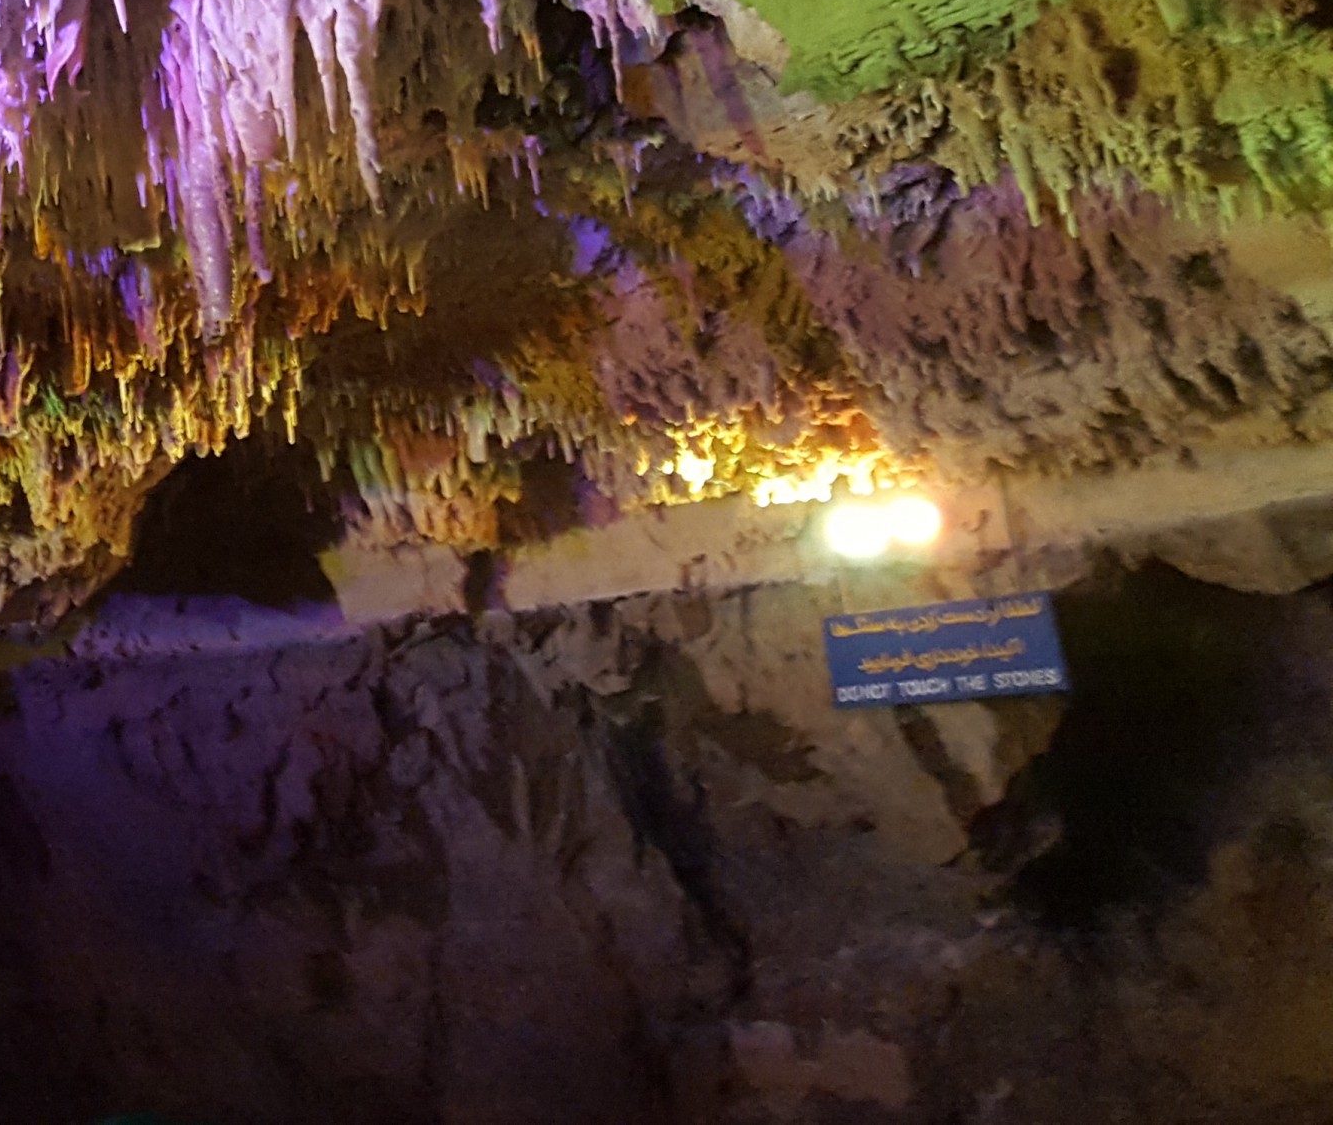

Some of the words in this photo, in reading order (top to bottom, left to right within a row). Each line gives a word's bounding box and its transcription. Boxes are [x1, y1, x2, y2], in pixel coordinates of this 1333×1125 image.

[897, 677, 949, 697] TOUCH
[956, 674, 986, 692] THE
[994, 668, 1060, 689] STONES
